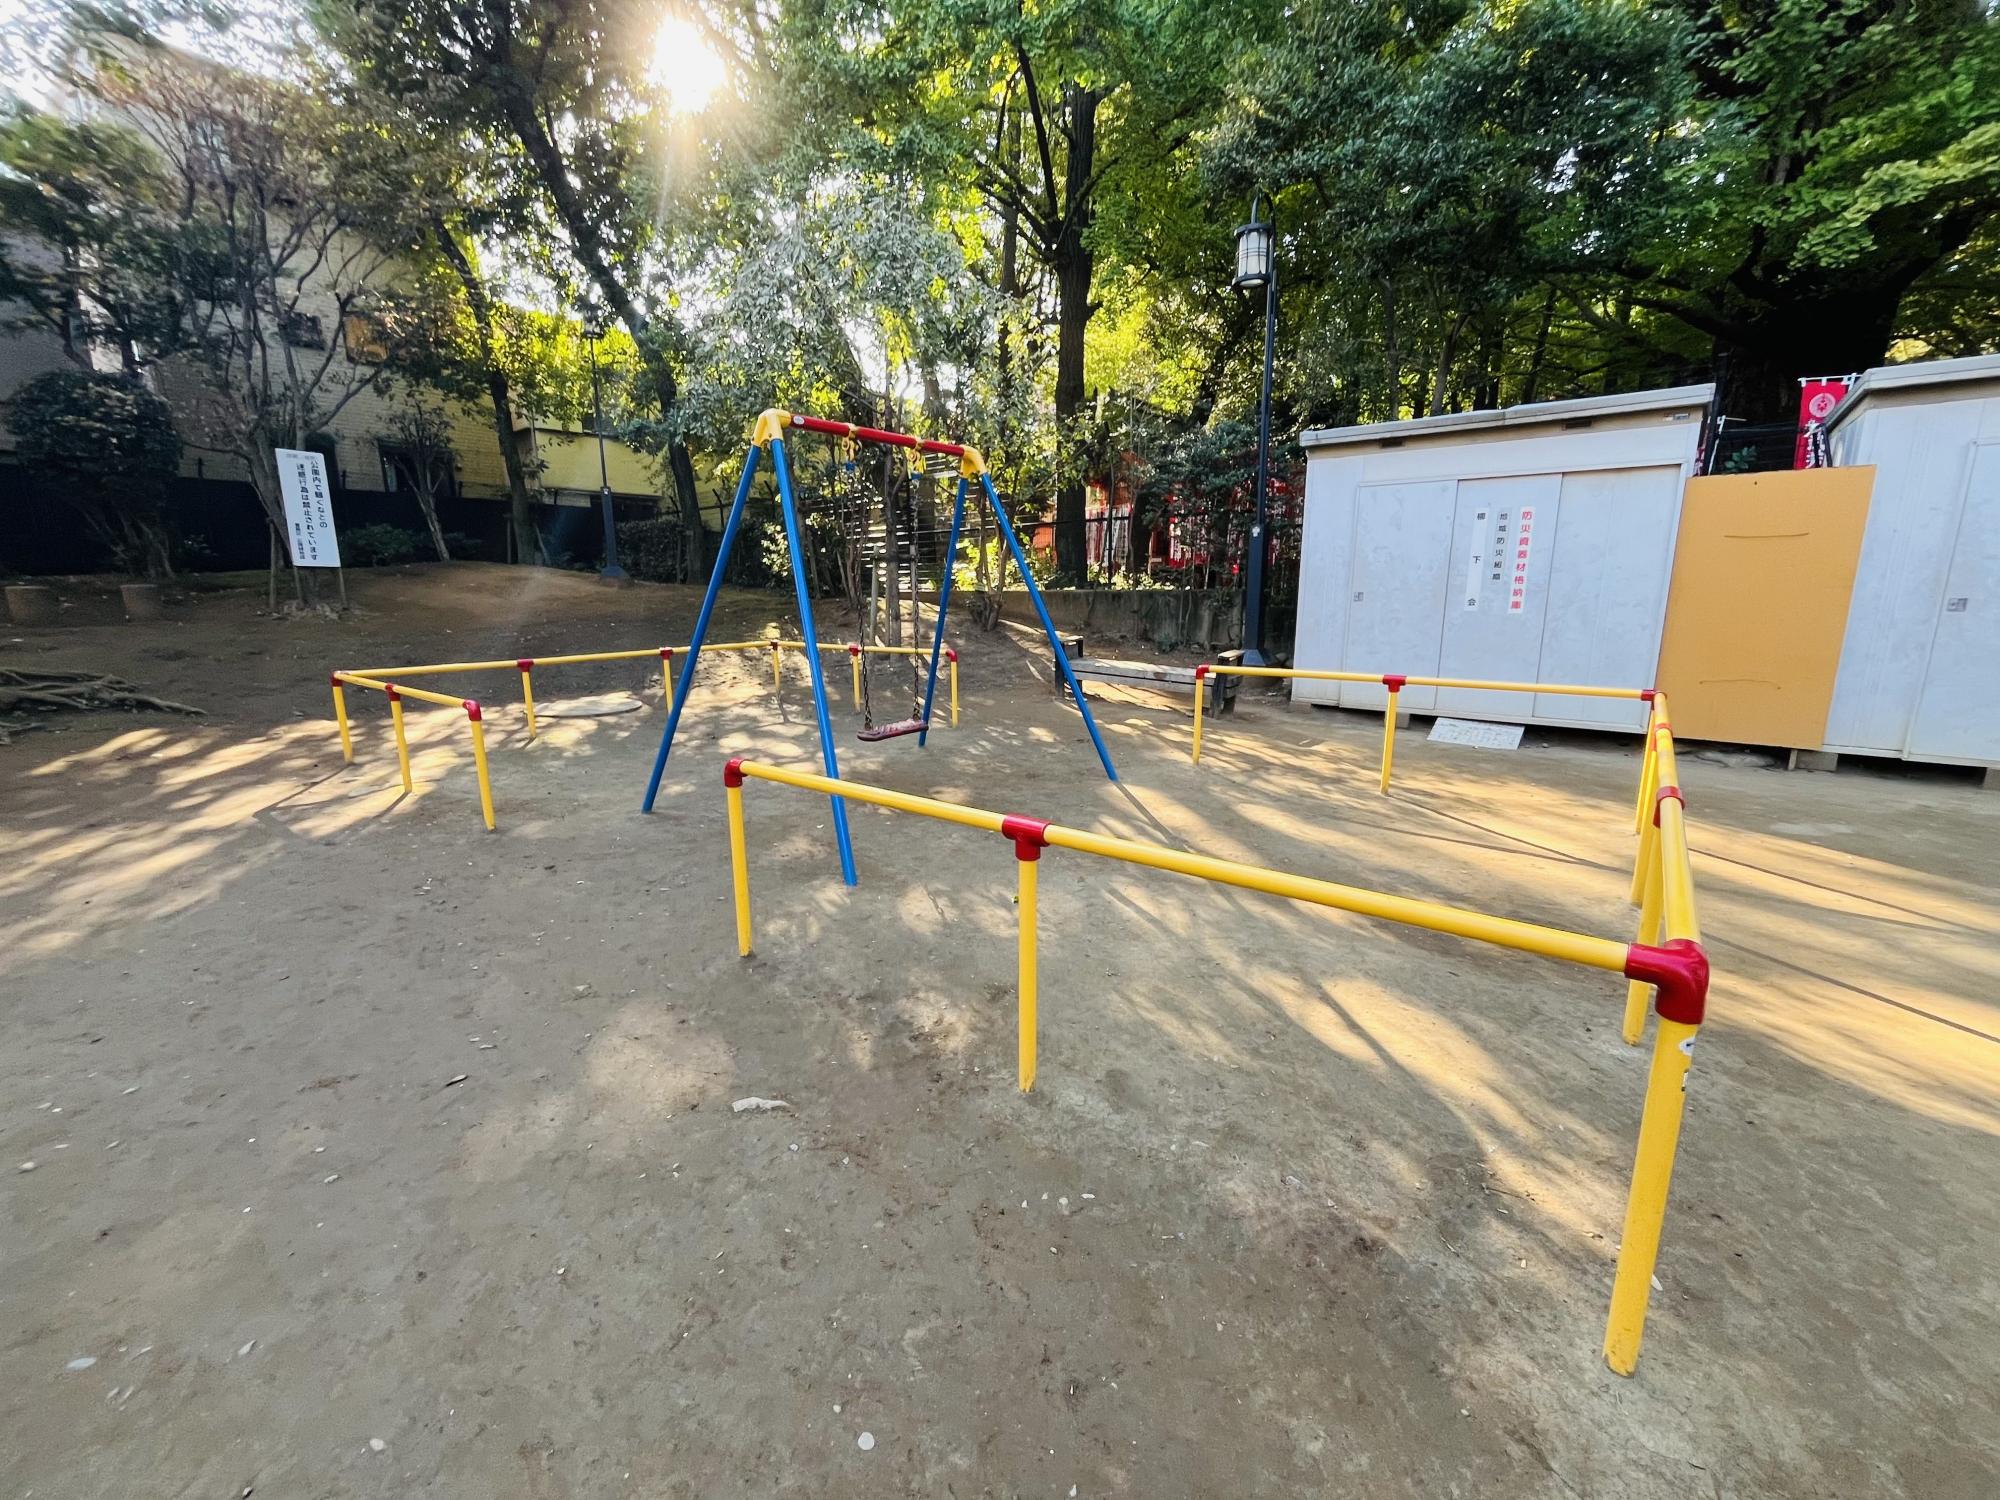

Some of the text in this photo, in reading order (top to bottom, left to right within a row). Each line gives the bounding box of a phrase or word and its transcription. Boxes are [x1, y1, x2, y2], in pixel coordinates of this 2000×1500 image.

[1492, 513, 1508, 580] 地域防災組織
[1510, 511, 1533, 609] 防災資器材格納庫
